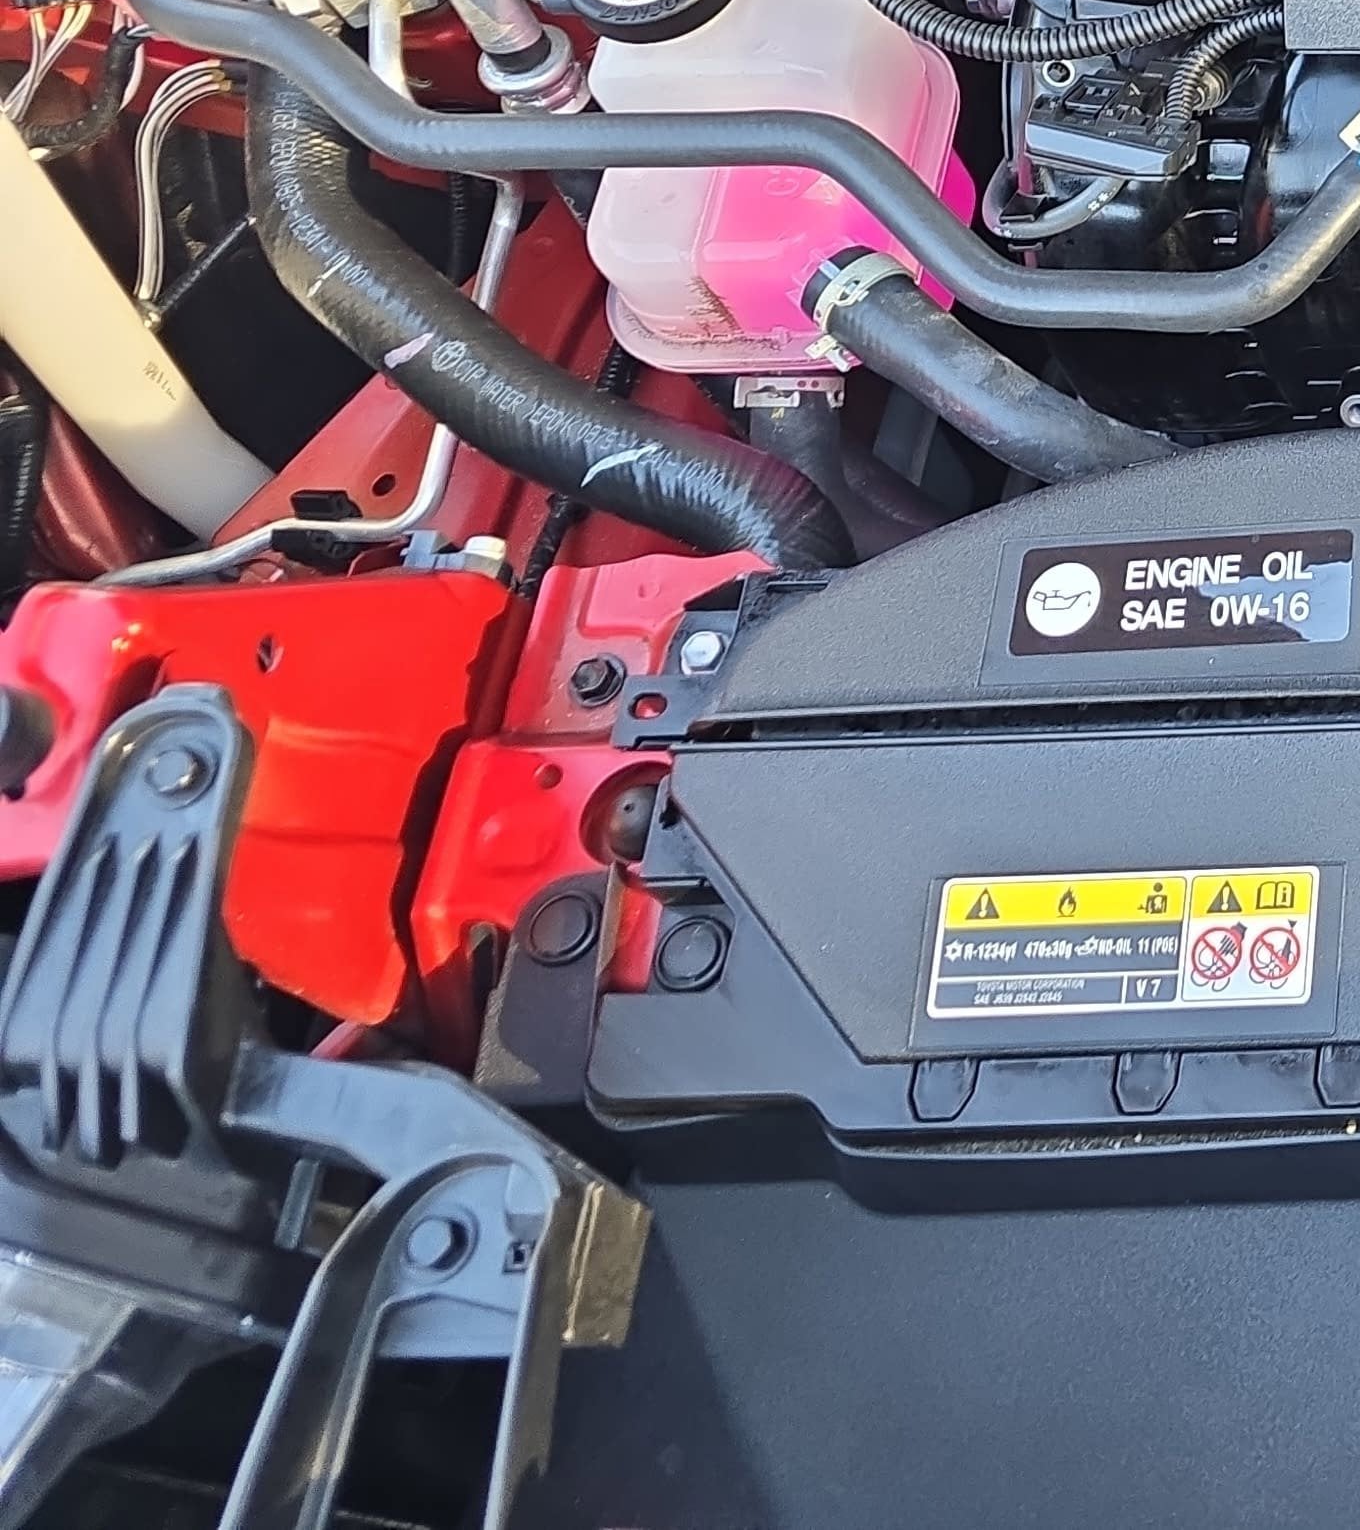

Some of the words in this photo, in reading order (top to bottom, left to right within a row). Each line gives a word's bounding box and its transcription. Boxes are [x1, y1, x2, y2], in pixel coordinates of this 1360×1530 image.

[480, 375, 527, 415] WATER
[1124, 553, 1242, 591] ENGINE
[1262, 550, 1313, 582] OIL
[1120, 597, 1187, 632] SAE
[1210, 591, 1310, 627] 0W-16
[1150, 978, 1162, 997] 7
